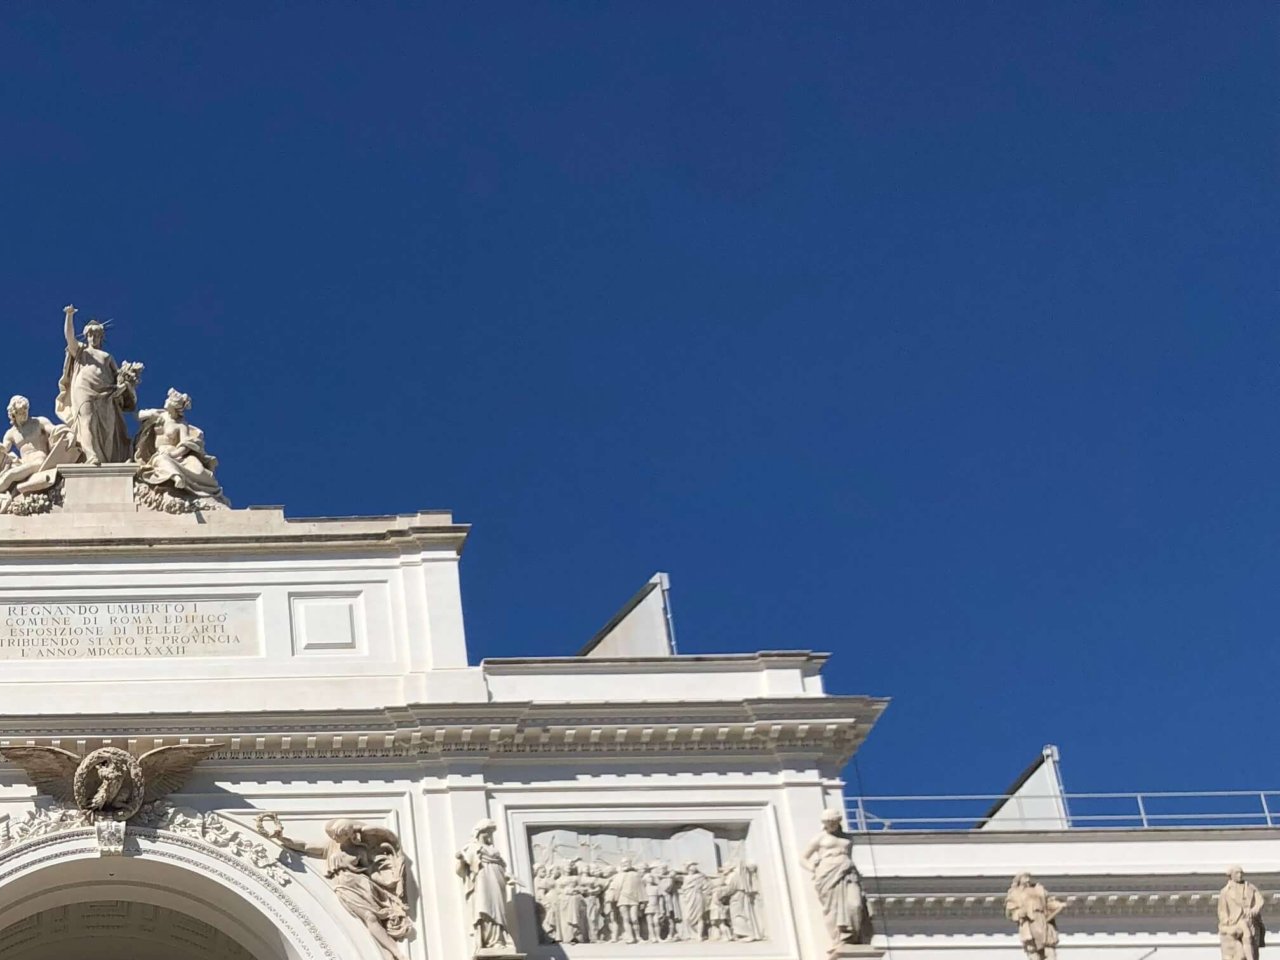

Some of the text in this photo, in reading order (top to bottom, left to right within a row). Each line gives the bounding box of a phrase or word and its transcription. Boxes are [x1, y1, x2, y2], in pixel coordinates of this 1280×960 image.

[8, 603, 198, 616] REGNANDO UMBERTO I
[5, 617, 71, 626] COMUNE
[83, 616, 97, 625] DI
[110, 615, 152, 625] ROMA
[10, 626, 104, 637] ESPOSIZIONE
[113, 626, 126, 635] DI
[137, 625, 181, 635] BELLE
[191, 624, 225, 634] ARTI
[88, 636, 135, 646] STATO
[145, 636, 152, 645] E
[162, 634, 240, 645] PROVINCIA
[87, 646, 185, 656] MDCCCLXXXII
